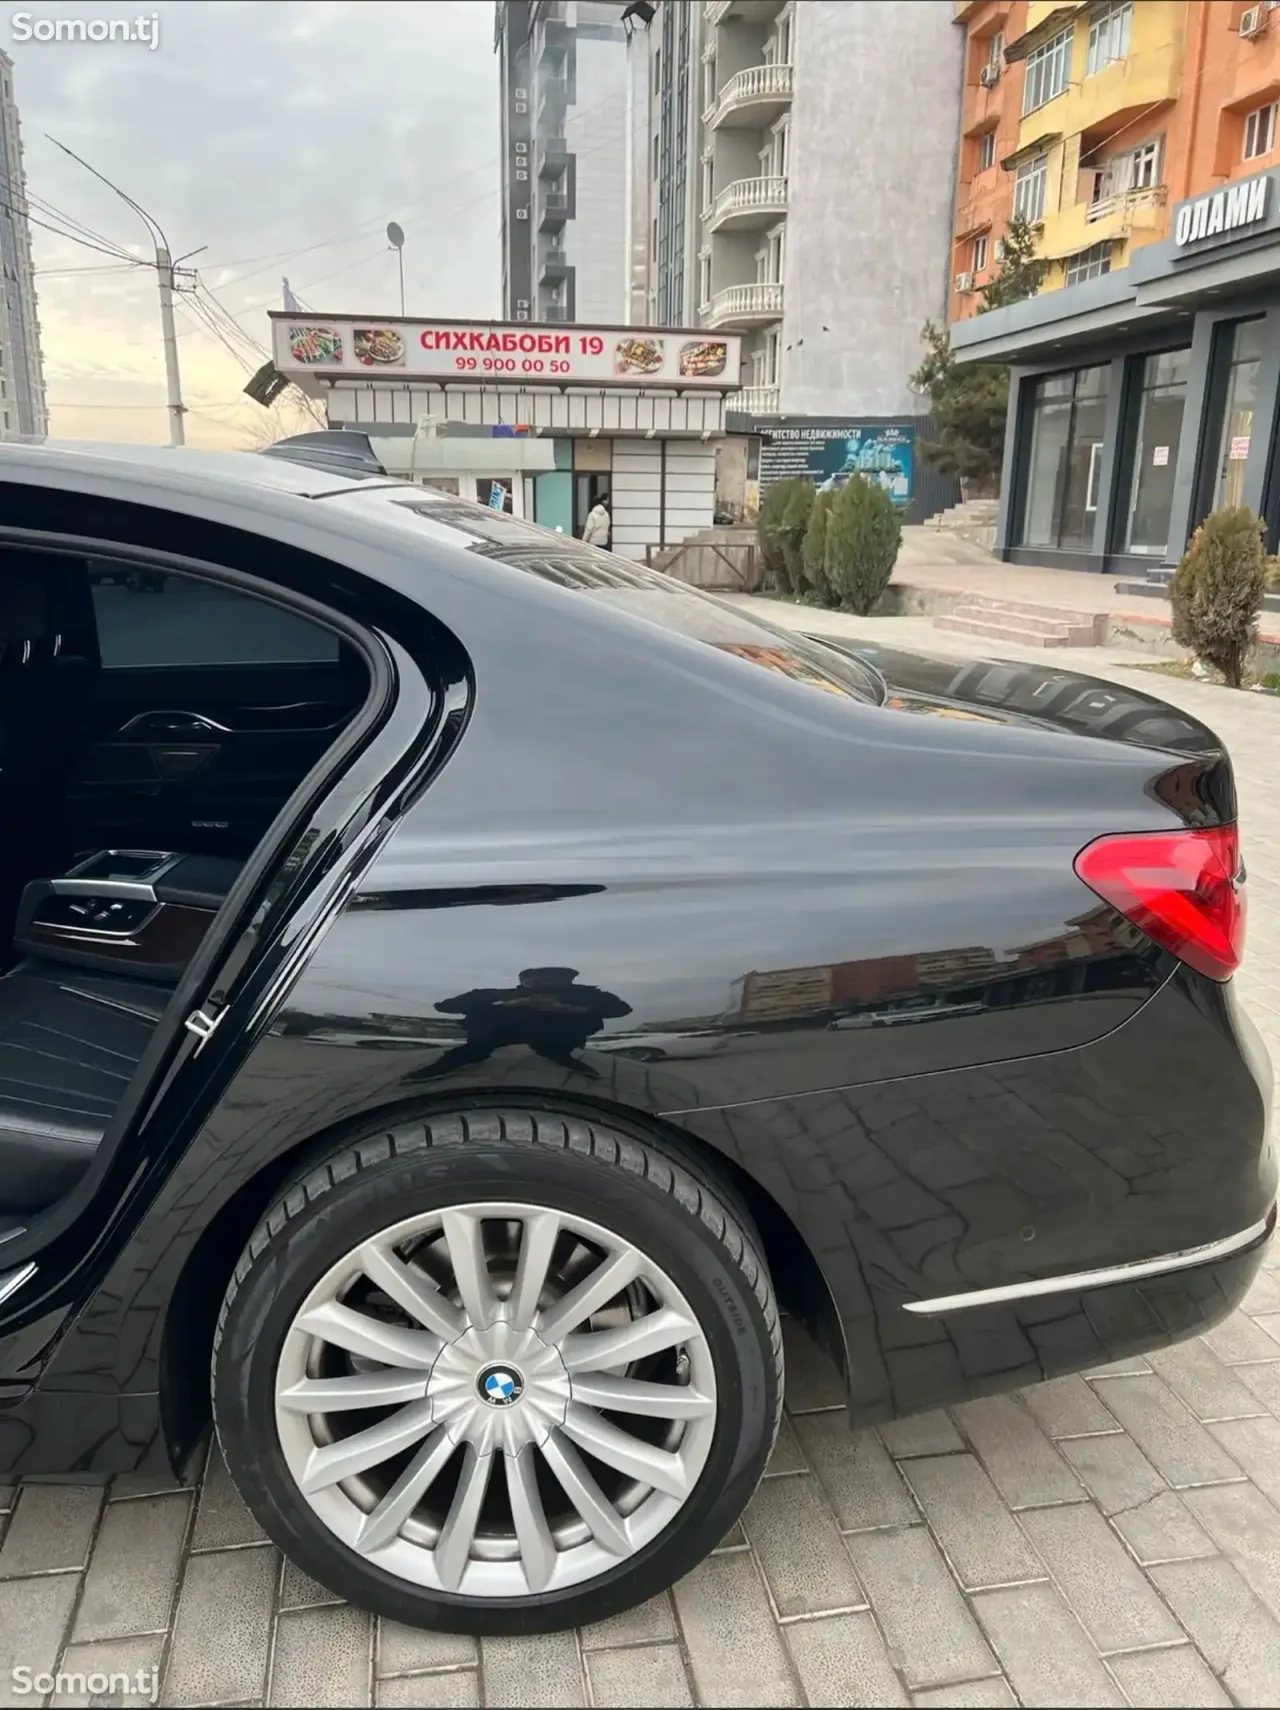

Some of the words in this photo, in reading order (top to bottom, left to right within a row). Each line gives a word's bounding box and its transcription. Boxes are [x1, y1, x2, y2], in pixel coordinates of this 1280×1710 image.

[1175, 175, 1268, 247] ОЛАМИ
[420, 330, 571, 354] СИХКАБОБИ
[579, 336, 604, 355] 19
[455, 357, 477, 370] 99
[483, 357, 516, 371] 900
[522, 359, 544, 372] 00
[550, 360, 570, 373] 50
